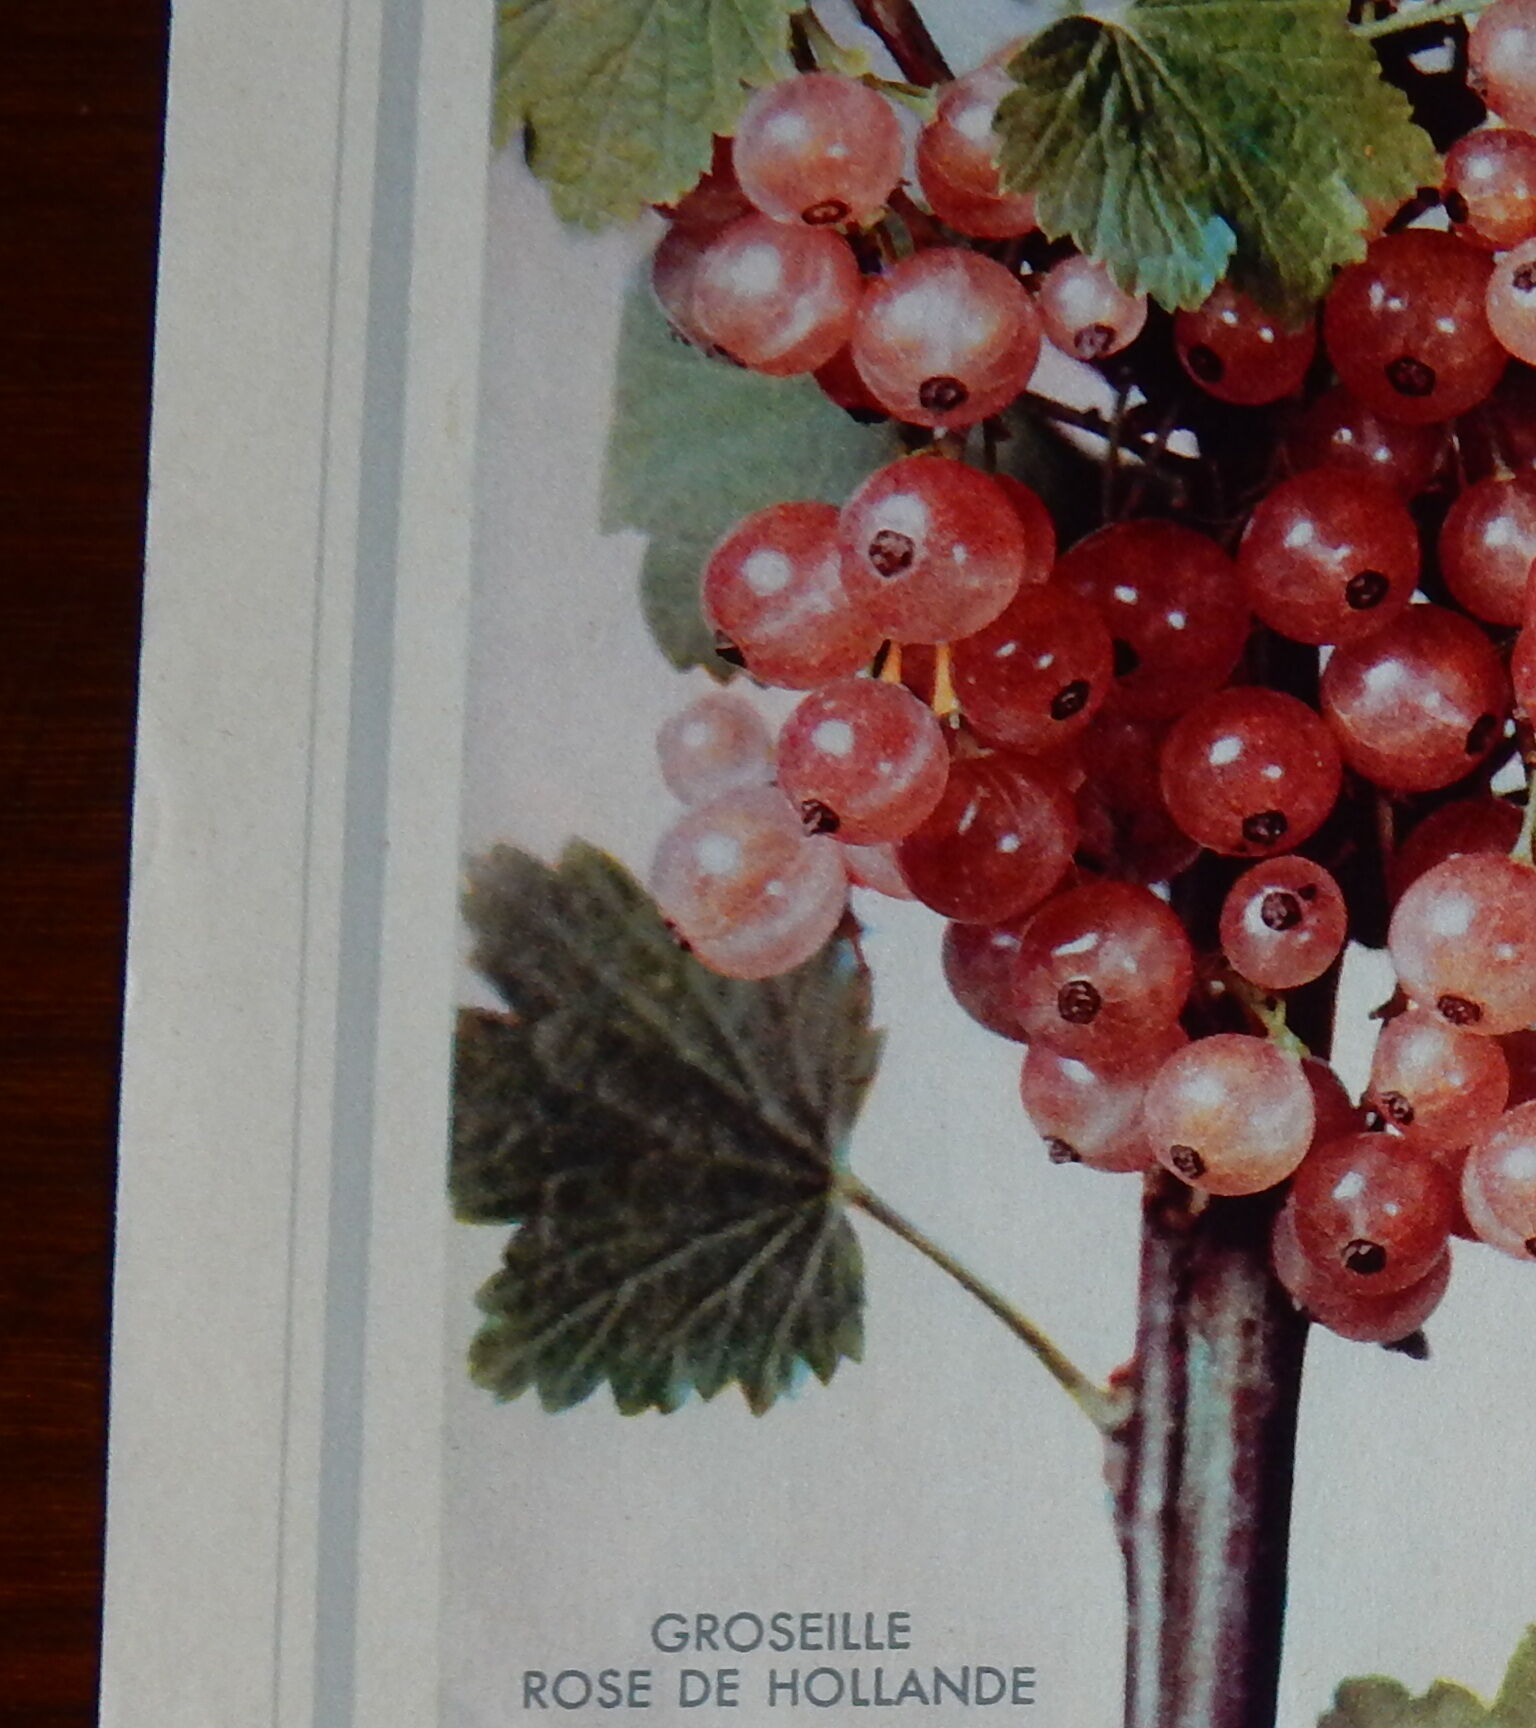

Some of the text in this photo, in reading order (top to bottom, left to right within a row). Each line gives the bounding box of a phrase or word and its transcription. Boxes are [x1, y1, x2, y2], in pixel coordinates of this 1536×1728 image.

[650, 1611, 911, 1653] GROSEILLE
[522, 1666, 1037, 1710] ROSE DE HOLLANDE
